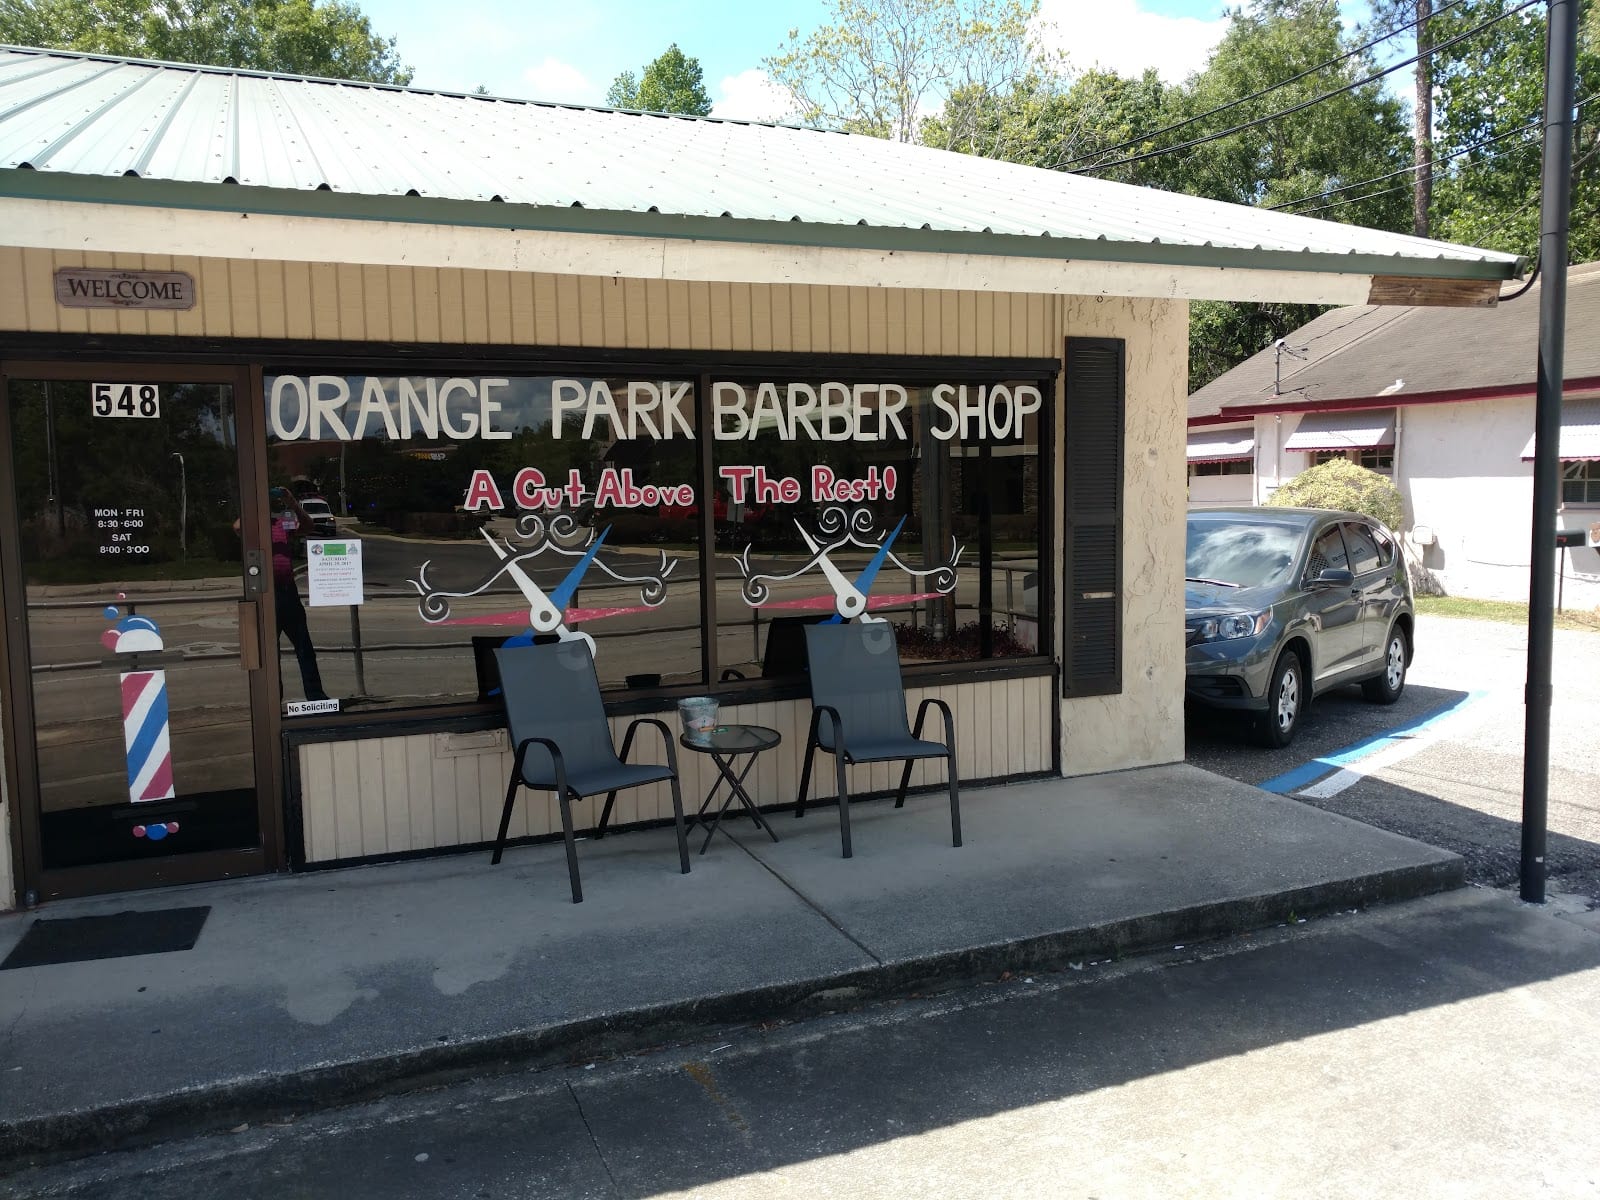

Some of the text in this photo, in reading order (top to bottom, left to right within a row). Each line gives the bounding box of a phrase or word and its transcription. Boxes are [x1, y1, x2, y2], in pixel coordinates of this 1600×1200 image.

[68, 278, 183, 300] WELCOME
[95, 385, 157, 416] 548
[270, 375, 1042, 441] ORANGE PARK BARBER SHOP
[464, 465, 897, 510] A Cut Above The Rest!
[94, 509, 144, 517] MON FRI
[97, 520, 118, 528] 8:30
[111, 533, 132, 542] SAT
[288, 702, 338, 713] No Soliciting
